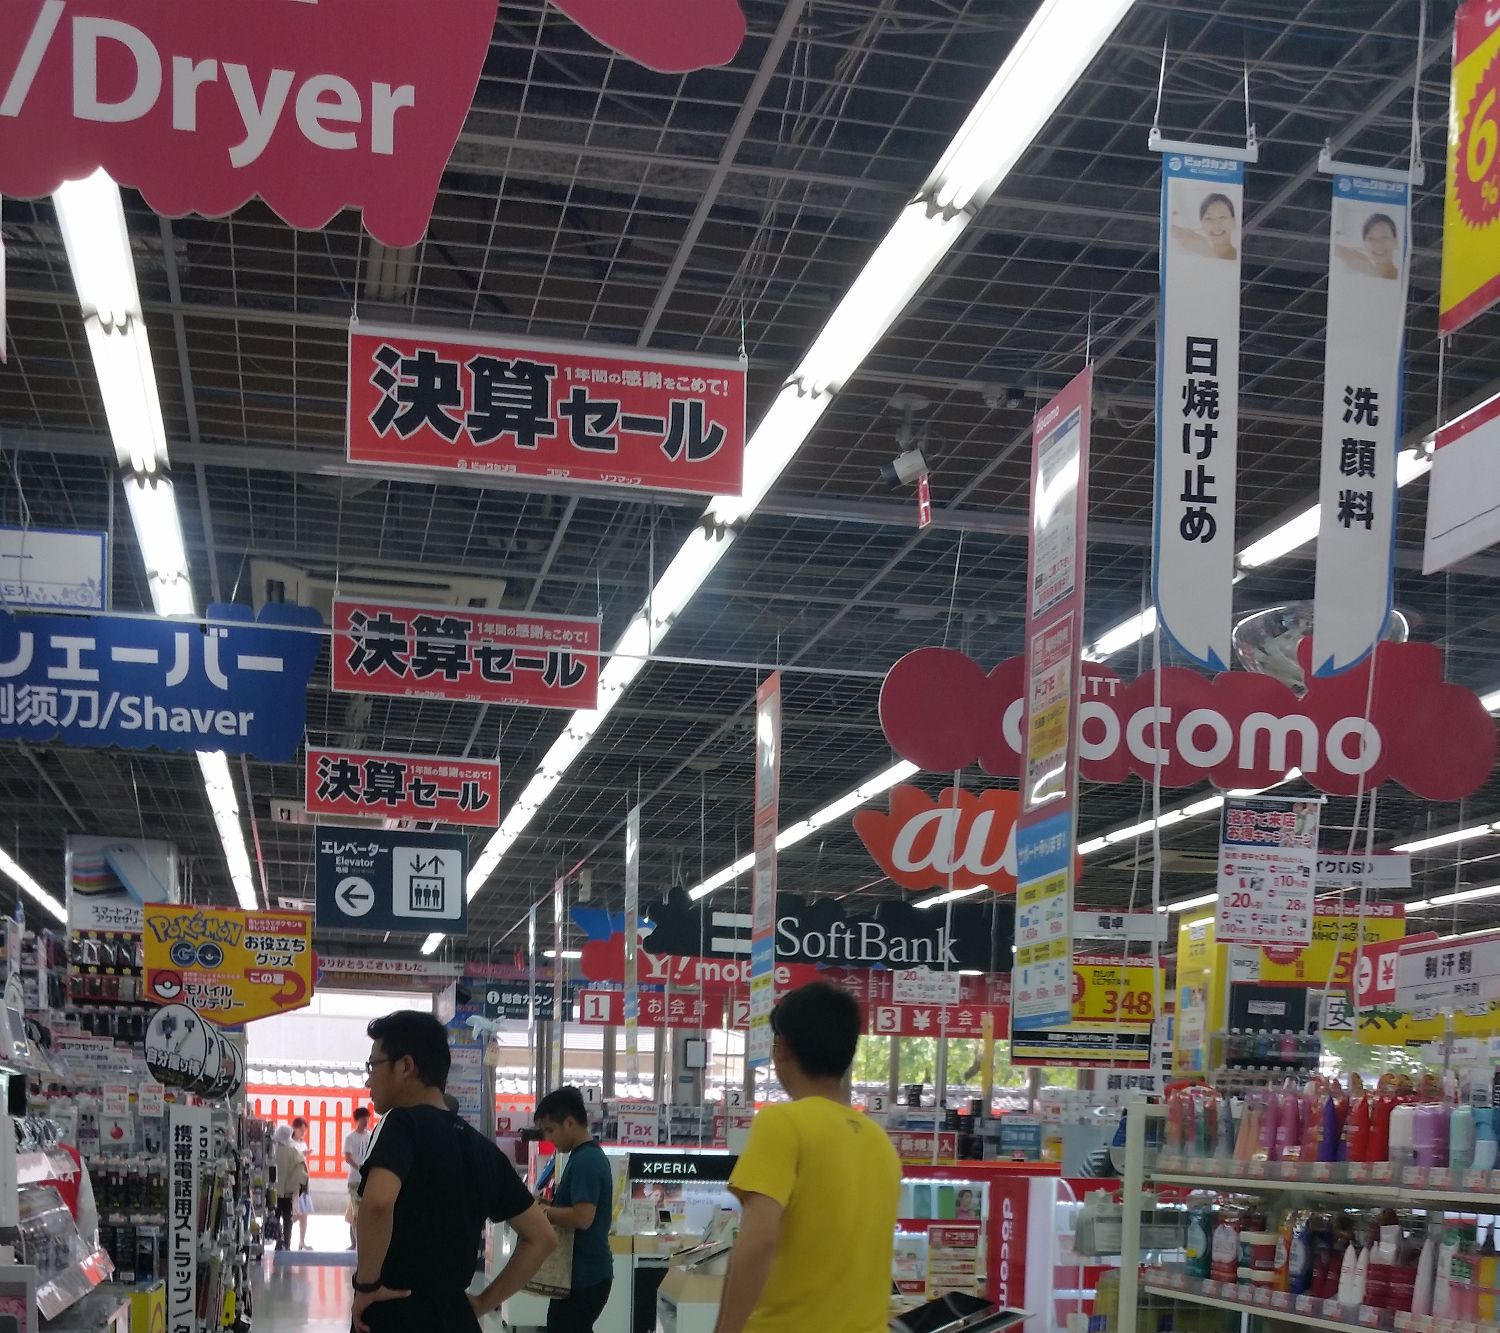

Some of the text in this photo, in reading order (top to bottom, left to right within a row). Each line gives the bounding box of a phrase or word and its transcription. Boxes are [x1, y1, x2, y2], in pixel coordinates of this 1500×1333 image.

[369, 343, 727, 463] 決算セール
[1179, 336, 1219, 543] 日焼け止め
[1338, 386, 1378, 530] 洗顔料
[346, 610, 587, 688] 決算セール
[315, 756, 490, 812] 決算セール
[321, 841, 389, 857] エレベーター
[335, 856, 375, 868] Elevator
[92, 906, 143, 916] スマートフォ
[1098, 916, 1124, 930] 電卓
[244, 935, 306, 953] お役立ち
[775, 916, 961, 964] SoftBank
[170, 941, 224, 969] GO
[1425, 950, 1473, 980] 制汗剤
[501, 992, 573, 1006] 総合カウンー
[590, 997, 604, 1019] 1
[648, 998, 709, 1017] お会計
[1102, 990, 1152, 1015] 348
[881, 1008, 897, 1030] 3
[587, 1088, 594, 1102] 1
[732, 1093, 740, 1106] 2
[875, 1098, 883, 1111] 3
[624, 1121, 652, 1137] Tax
[643, 1162, 698, 1175] XPERIA
[1000, 1198, 1014, 1312] docom
